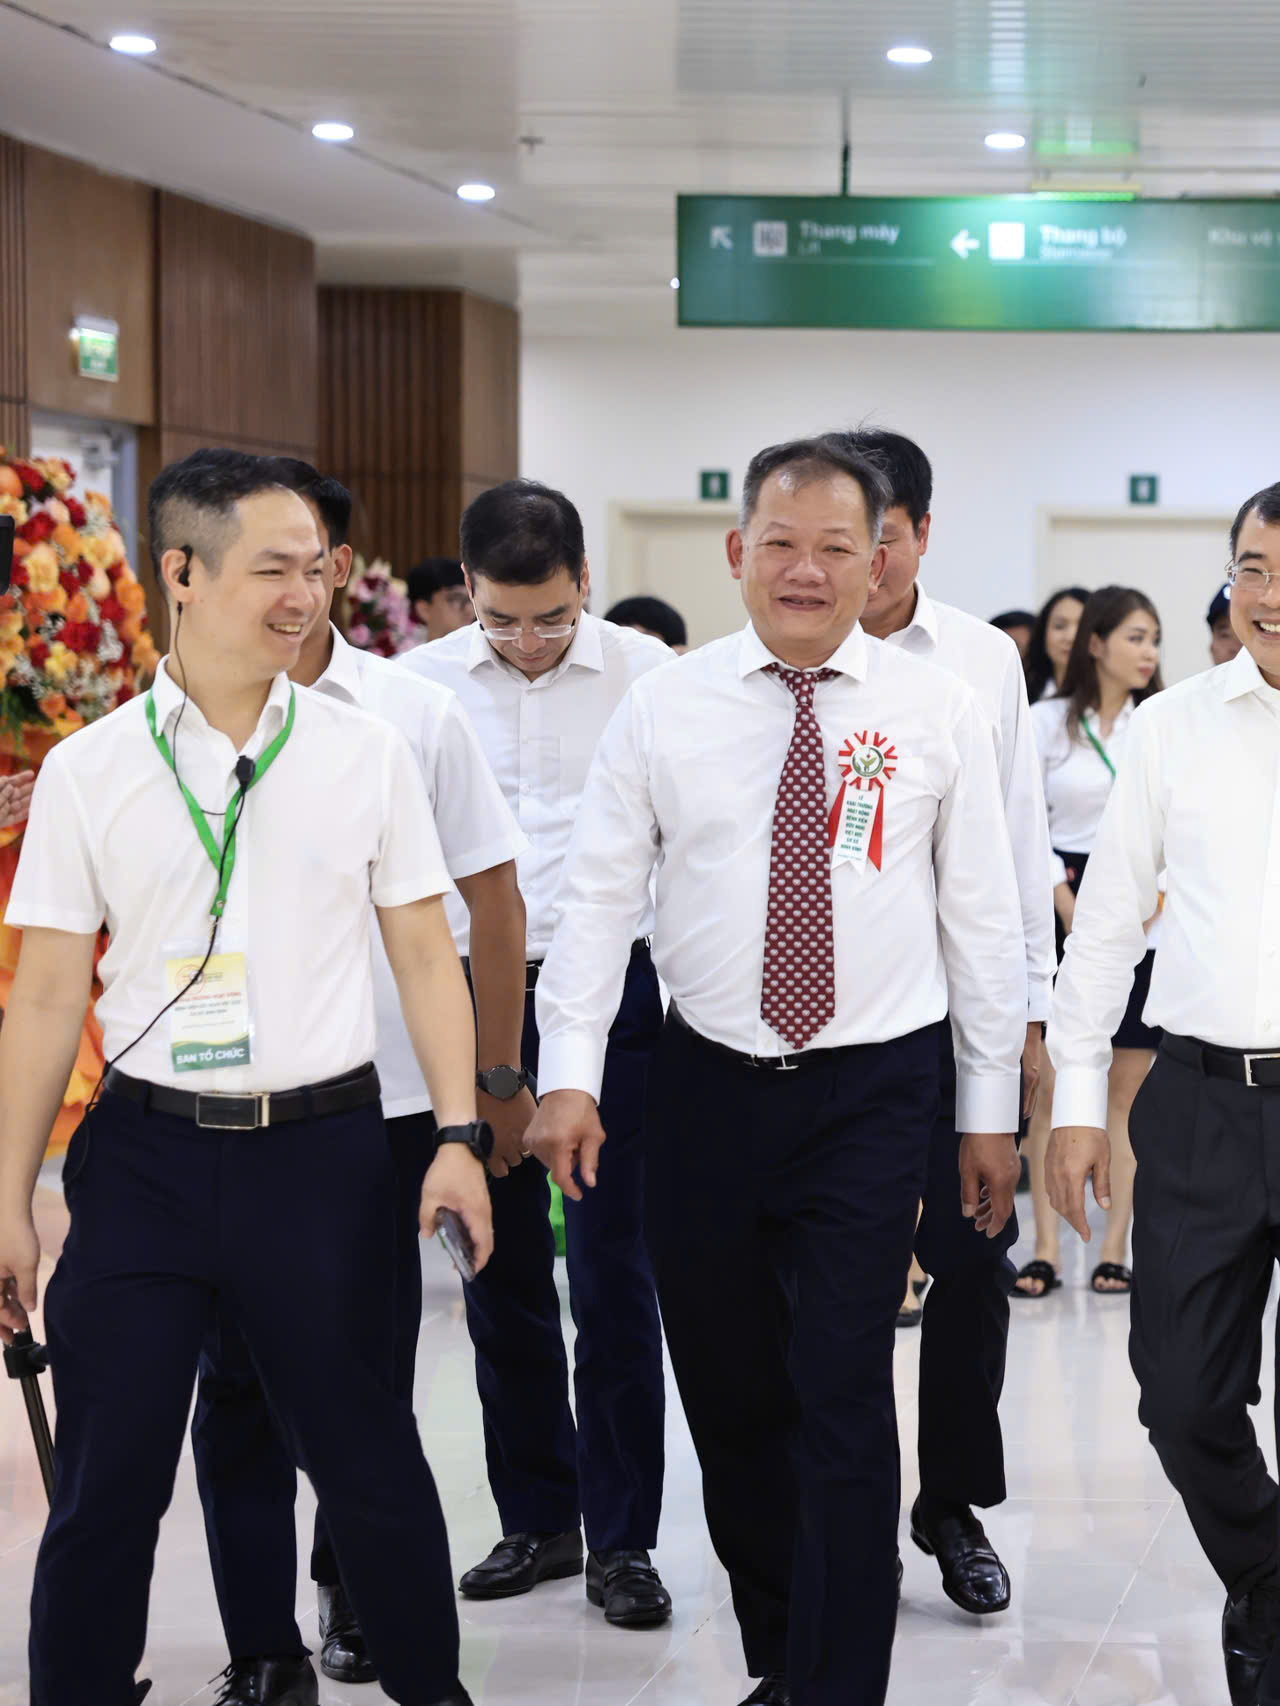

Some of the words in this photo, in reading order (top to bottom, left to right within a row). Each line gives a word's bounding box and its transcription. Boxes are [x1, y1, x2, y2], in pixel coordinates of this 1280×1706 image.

[800, 220, 857, 245] Thang
[860, 220, 899, 246] máy
[176, 1053, 197, 1065] BAN
[199, 1048, 213, 1063] TỔ
[215, 1047, 246, 1060] CHỨC
